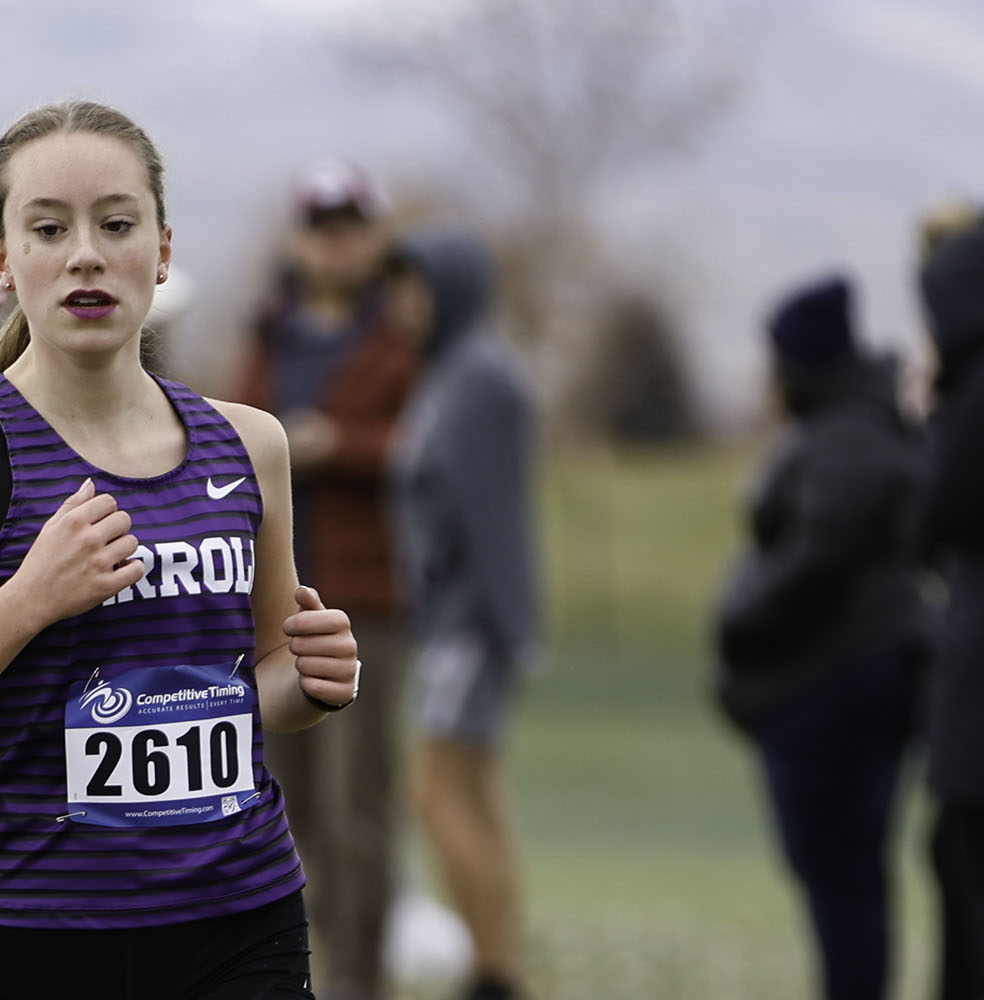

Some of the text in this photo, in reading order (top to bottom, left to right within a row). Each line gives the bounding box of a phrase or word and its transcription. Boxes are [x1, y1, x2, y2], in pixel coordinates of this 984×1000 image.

[103, 537, 255, 606] RROL
[138, 706, 174, 715] ACCURATE
[176, 702, 205, 712] RESULTS
[85, 721, 239, 796] 2610
[125, 805, 214, 818] www.CompetitiveTiming.com
